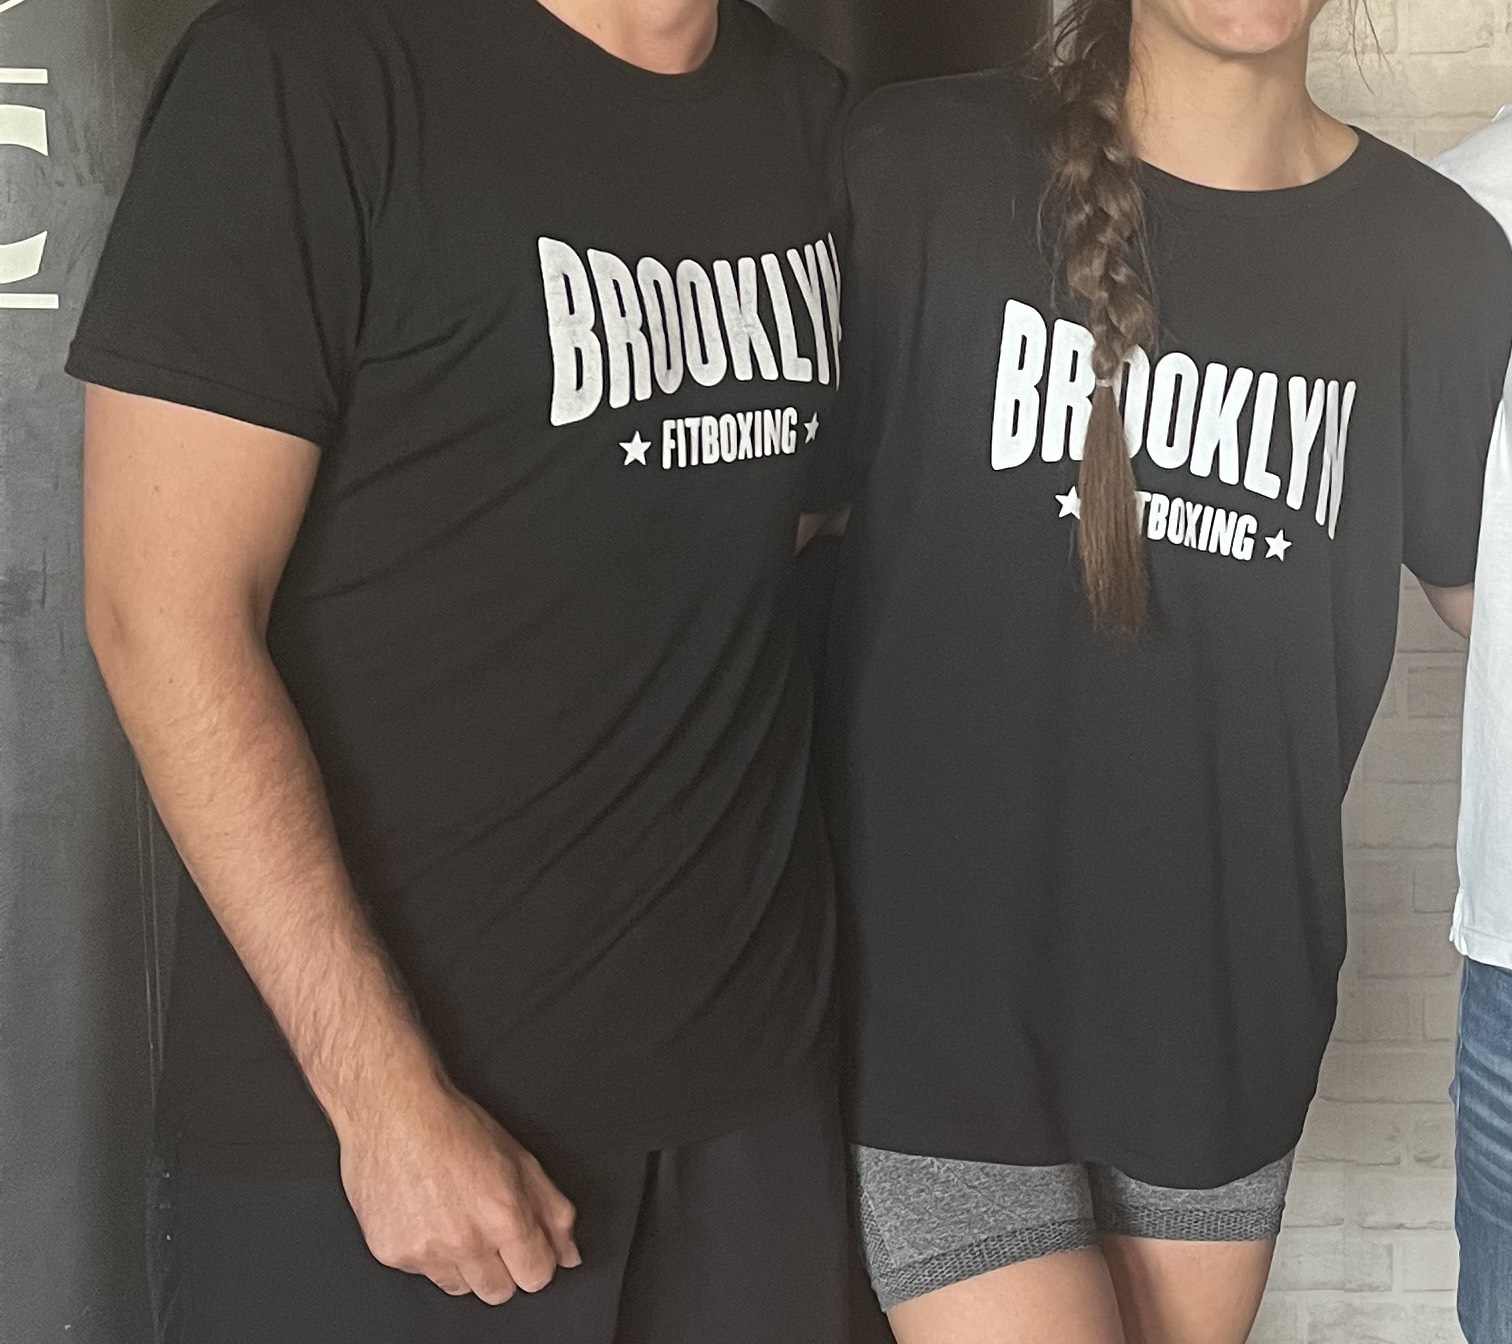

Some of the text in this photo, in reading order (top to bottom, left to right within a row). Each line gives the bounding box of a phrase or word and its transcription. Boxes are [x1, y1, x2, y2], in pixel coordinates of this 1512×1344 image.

[538, 232, 842, 427] BROOKLYN
[990, 298, 1357, 540] BROOKLYN
[661, 406, 798, 471] FITBOXING
